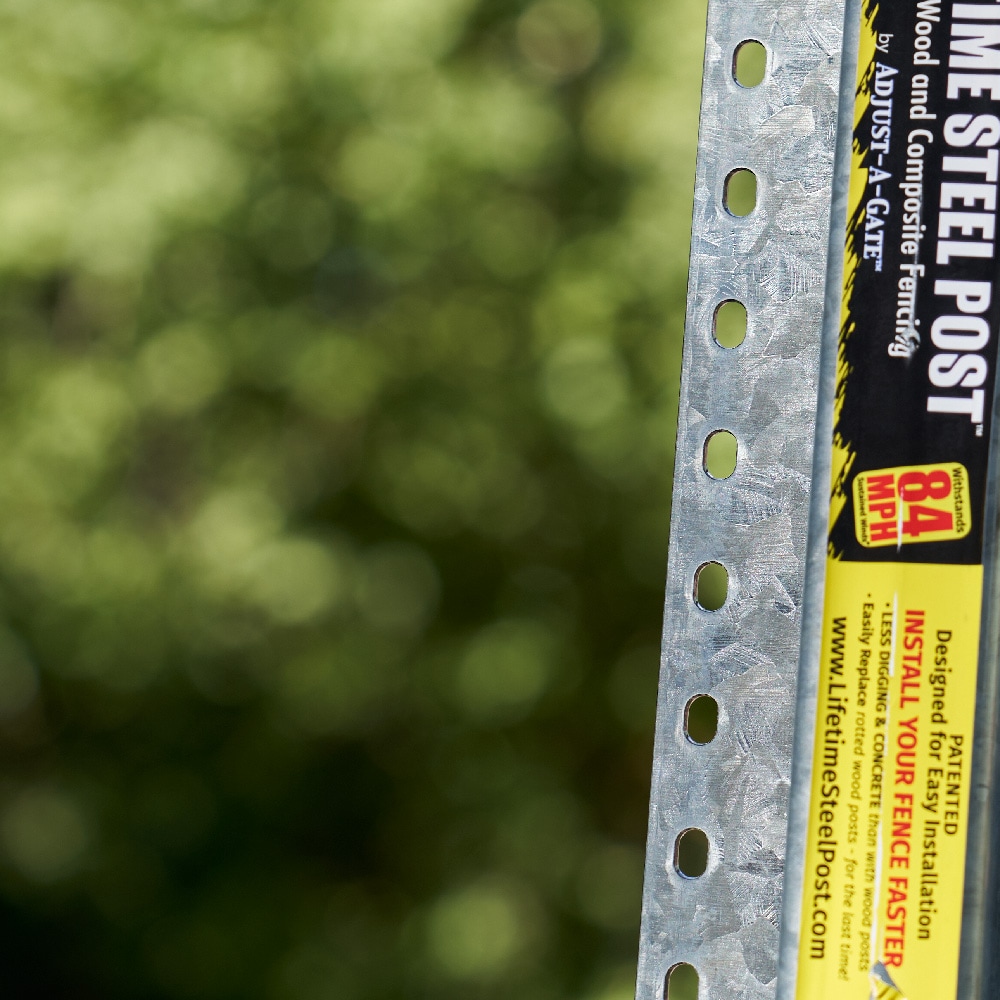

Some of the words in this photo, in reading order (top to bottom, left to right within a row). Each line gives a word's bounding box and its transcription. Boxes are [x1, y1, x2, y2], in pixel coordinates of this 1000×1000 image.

[875, 32, 894, 53] by
[909, 73, 937, 120] and
[898, 128, 935, 255] Composite
[888, 263, 925, 358] Fencing
[857, 477, 866, 516] Sustained
[866, 473, 898, 541] MPH
[898, 469, 953, 537] 84
[952, 467, 966, 533] Withstands
[858, 602, 874, 645] Easily
[879, 612, 893, 646] LESS
[855, 649, 871, 707] Replace
[875, 651, 890, 713] DIGGING
[899, 610, 925, 708] INSTALL
[929, 629, 953, 724] Designed
[853, 711, 865, 757] rotted
[875, 717, 886, 728] &
[895, 717, 919, 785] YOUR
[930, 732, 947, 760] for
[810, 617, 848, 959] www.LifetimeSteelPost.com
[850, 761, 863, 801] wood
[869, 733, 885, 808] CONCRETE
[922, 768, 943, 813] Easy
[944, 734, 963, 835] PATENTED
[847, 803, 859, 843] posts
[866, 814, 880, 851] than
[889, 793, 914, 869] FENCE
[843, 857, 858, 879] for
[864, 854, 876, 880] with
[917, 820, 940, 940] Installation
[842, 884, 855, 908] the
[861, 888, 873, 927] wood
[840, 911, 853, 939] last
[884, 877, 908, 967] FASTER
[858, 931, 870, 971] posts
